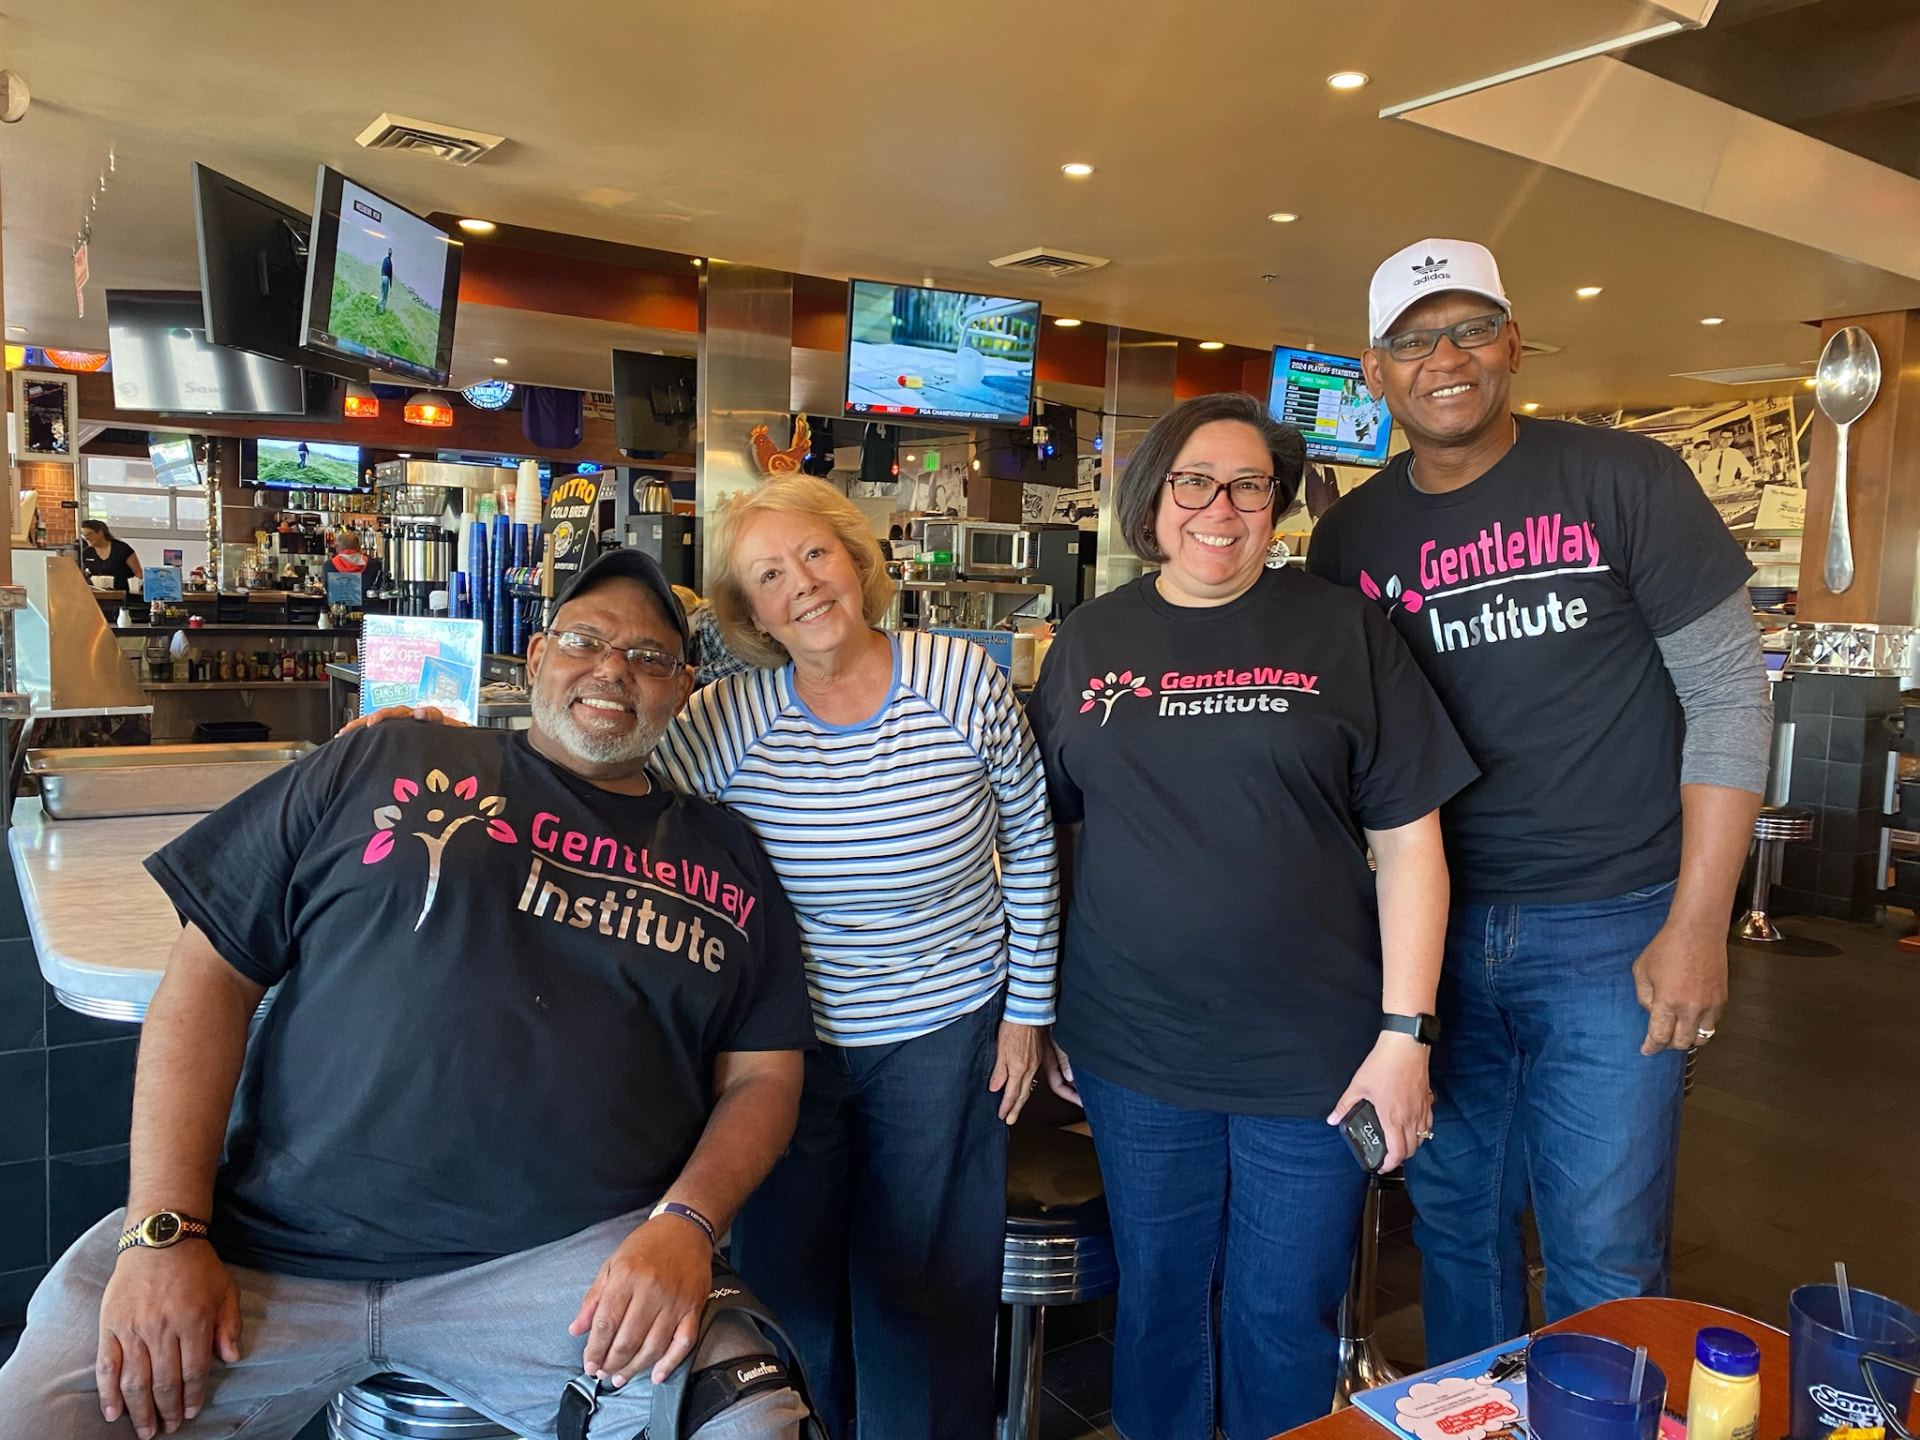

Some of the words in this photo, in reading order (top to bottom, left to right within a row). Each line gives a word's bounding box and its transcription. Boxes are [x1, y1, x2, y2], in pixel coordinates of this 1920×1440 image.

[1413, 273, 1451, 286] adidas
[1291, 361, 1307, 370] 2024
[1307, 365, 1331, 374] PLAYOFF
[1331, 367, 1359, 378] STATISTICS
[931, 409, 971, 418] CHAMPIONSHIP
[971, 412, 999, 420] FAVORITES
[551, 478, 596, 508] NITRO
[550, 505, 567, 519] COLD
[568, 505, 590, 518] BREW
[1420, 513, 1600, 590] GentleWay
[1429, 592, 1588, 653] Institute
[966, 633, 990, 644] Dessert
[990, 635, 1008, 645] Menu
[1160, 667, 1318, 691] GentleWay
[1158, 693, 1289, 716] Institute
[531, 811, 756, 928] GentleWay
[517, 857, 725, 973] Institute
